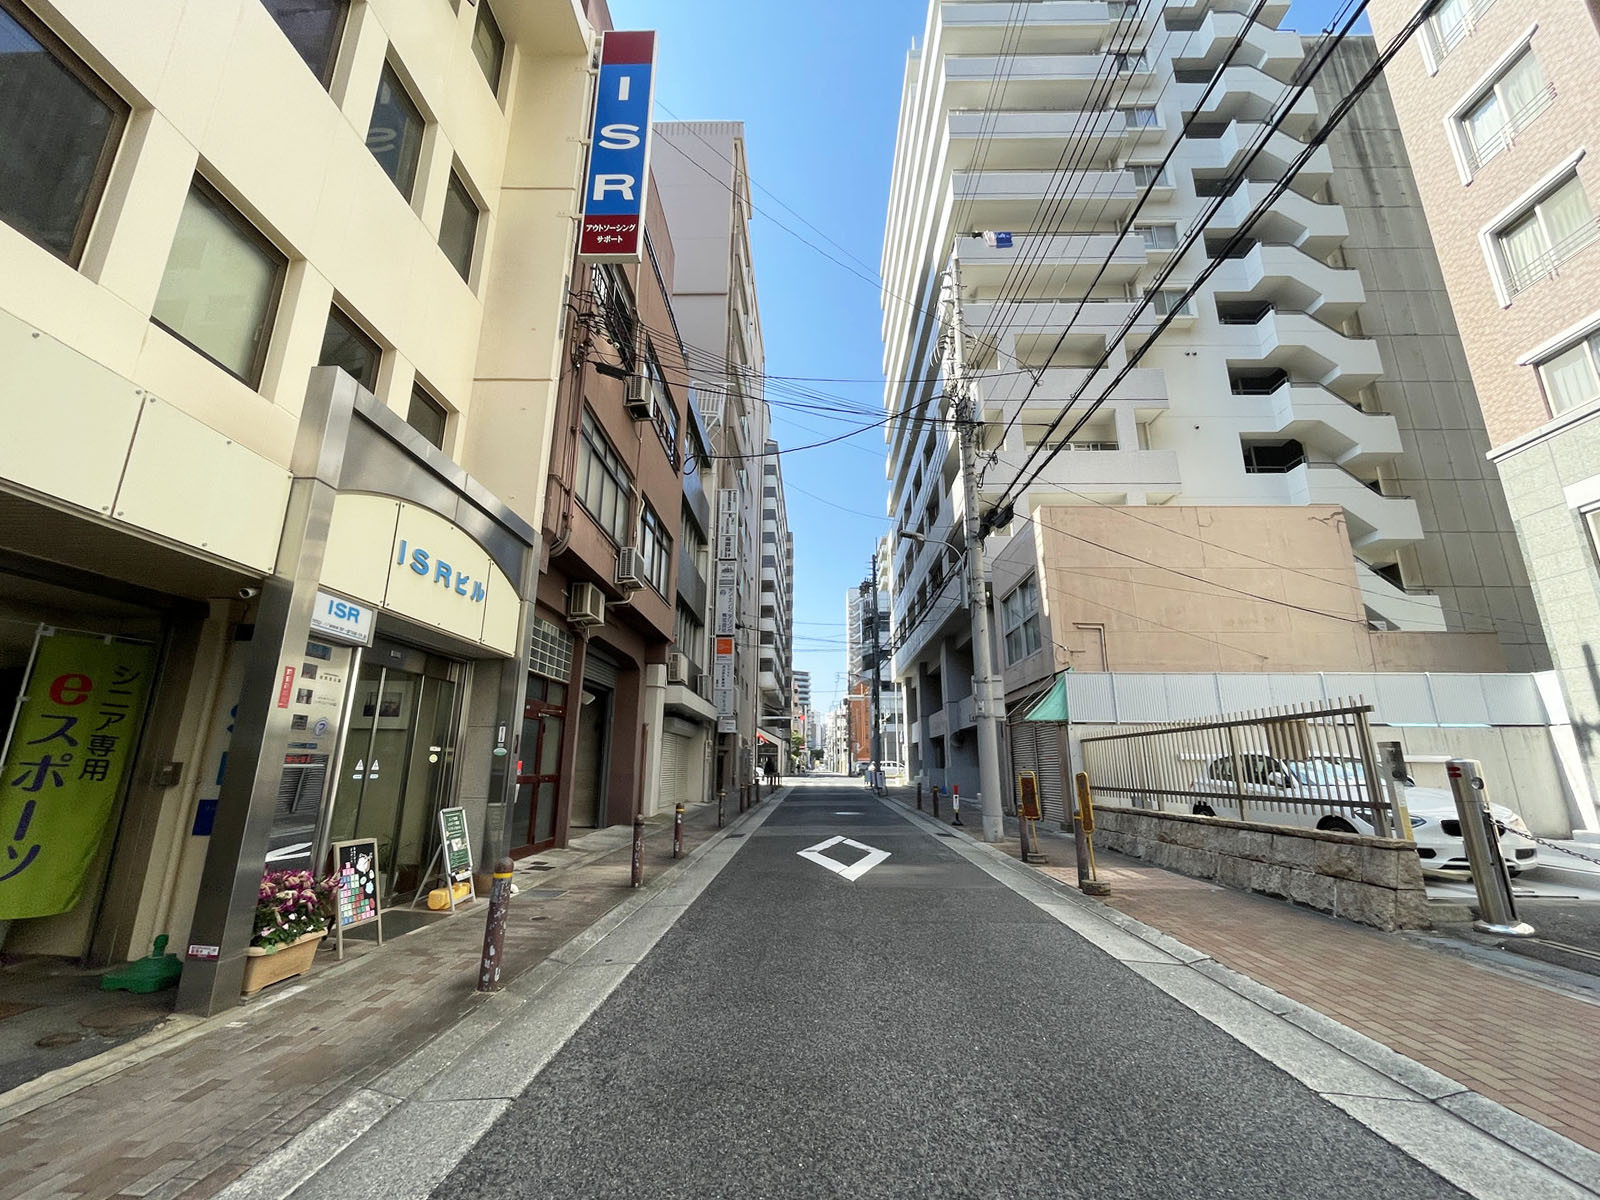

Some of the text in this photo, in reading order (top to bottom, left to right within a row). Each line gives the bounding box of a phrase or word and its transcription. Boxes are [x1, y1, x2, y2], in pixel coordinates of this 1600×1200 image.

[592, 76, 640, 201] ISR
[586, 222, 636, 234] アウトソーシング
[596, 234, 624, 245] サポート
[397, 539, 486, 604] ISRビル
[327, 599, 361, 624] ISR
[78, 665, 141, 783] シニア専用
